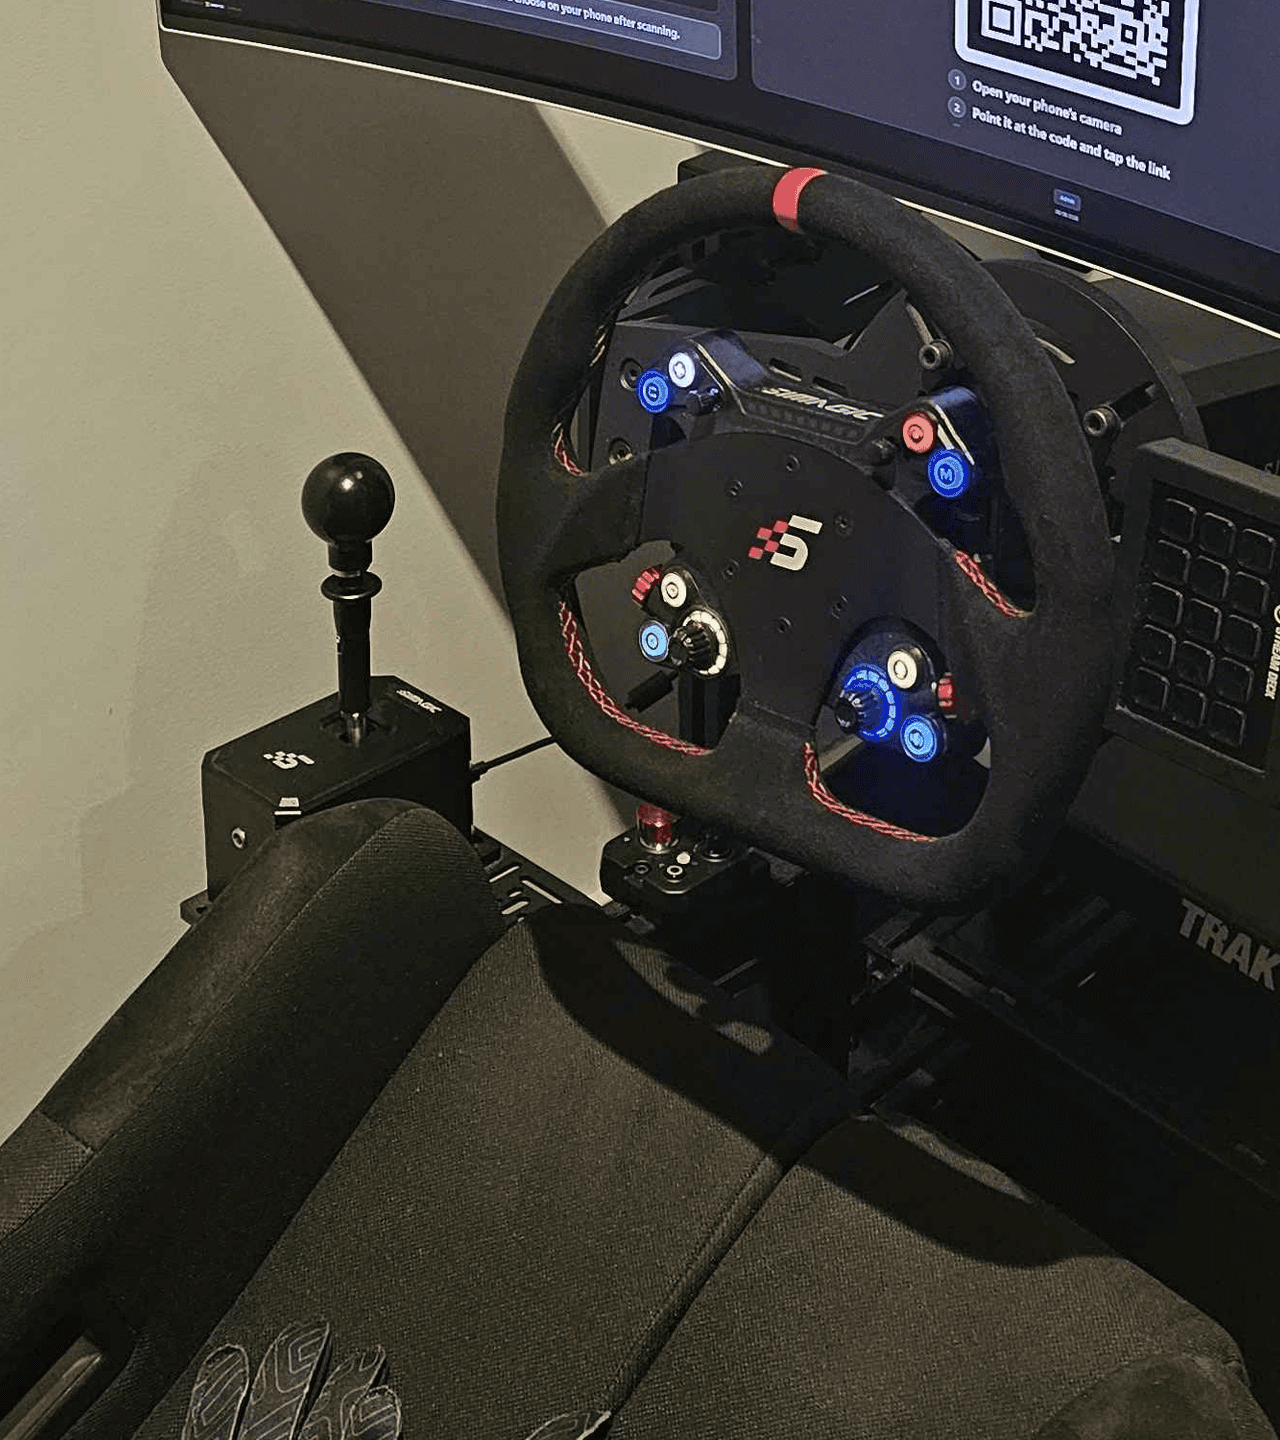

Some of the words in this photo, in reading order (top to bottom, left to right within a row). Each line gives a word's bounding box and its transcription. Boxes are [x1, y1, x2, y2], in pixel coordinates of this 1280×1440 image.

[547, 1, 561, 12] on
[560, 3, 582, 17] your
[583, 7, 613, 24] phone
[613, 12, 636, 29] after
[636, 20, 681, 41] scanning.
[953, 102, 961, 113] 2
[972, 80, 1003, 99] Open
[1005, 90, 1032, 107] your
[1032, 98, 1078, 122] phone's
[1079, 113, 1123, 136] camera
[972, 107, 1002, 128] Point
[1002, 116, 1013, 130] it
[1014, 121, 1027, 135] at
[1027, 123, 1048, 141] the
[1048, 132, 1079, 151] code
[1079, 140, 1102, 158] and
[1103, 148, 1124, 167] tap
[1125, 150, 1147, 172] the
[1148, 160, 1171, 180] link
[1264, 670, 1279, 700] DECK
